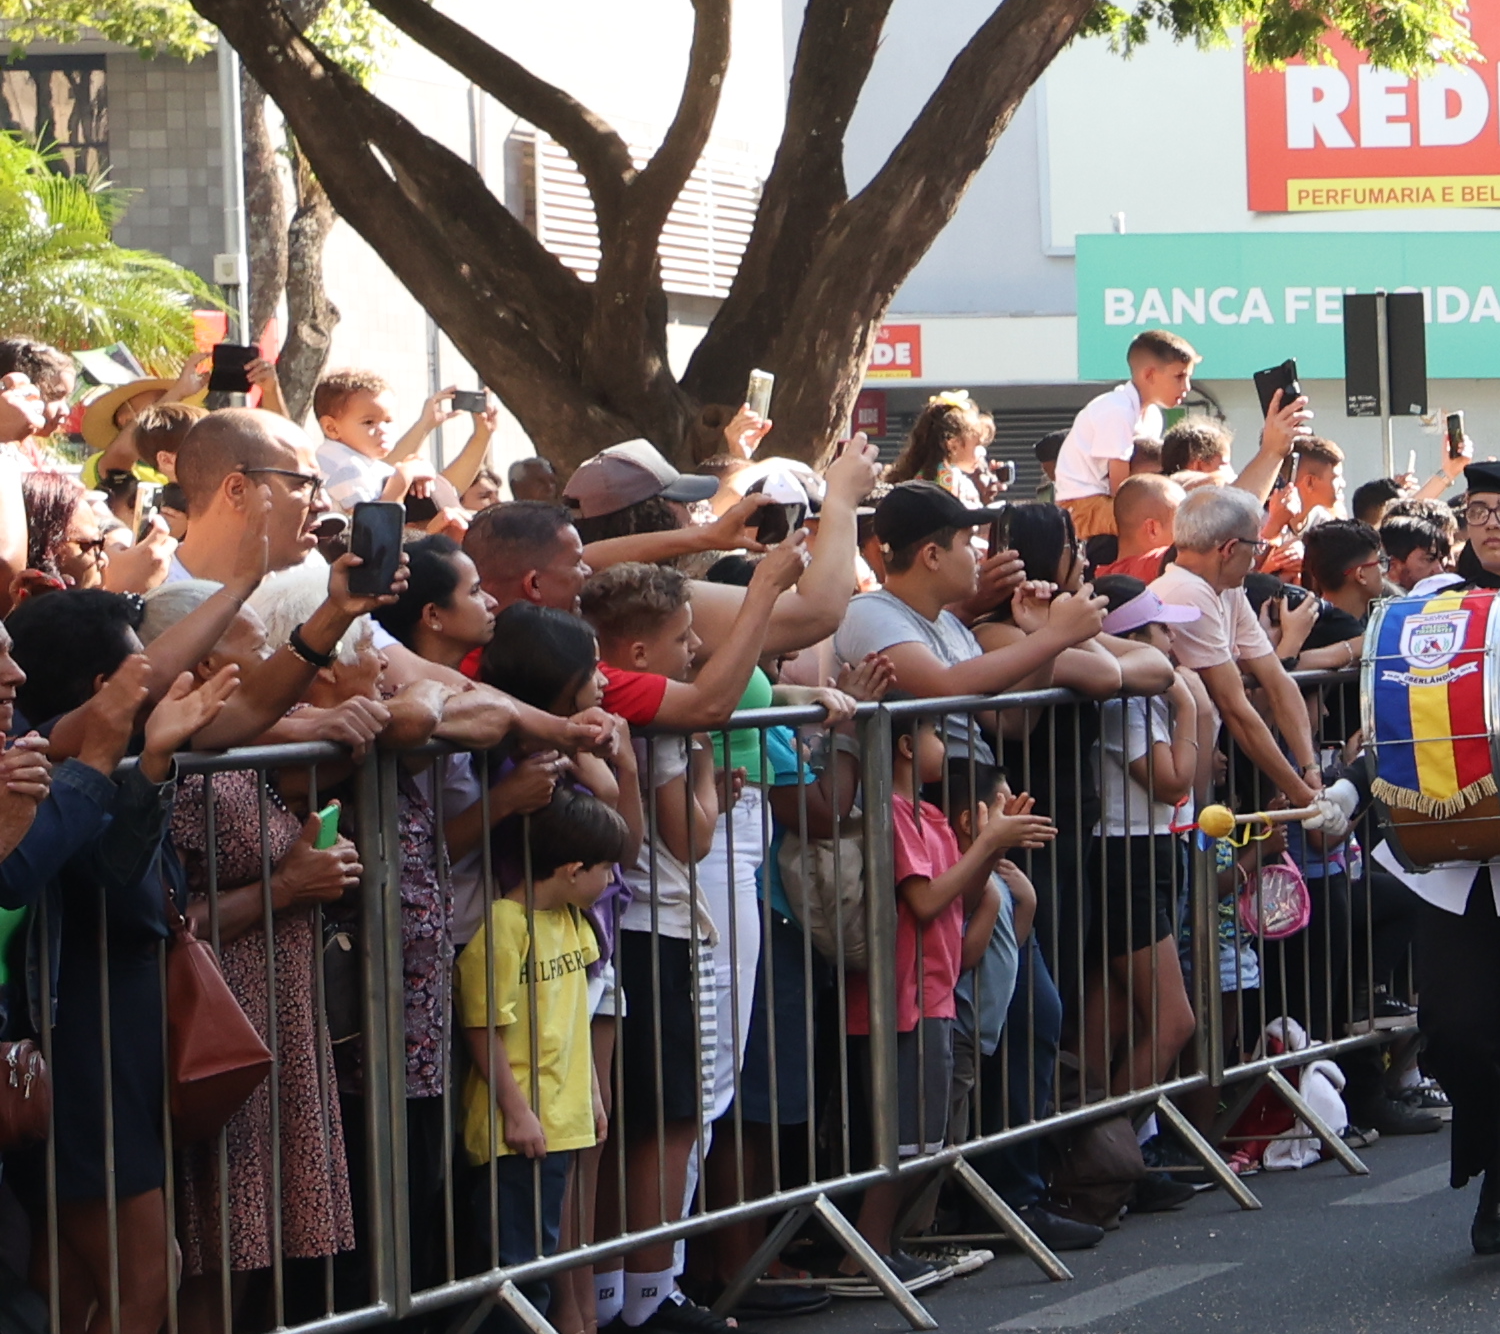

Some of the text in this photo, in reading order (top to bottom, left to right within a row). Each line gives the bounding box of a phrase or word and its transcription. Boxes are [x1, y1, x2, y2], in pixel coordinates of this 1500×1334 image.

[1297, 186, 1436, 206] PERFUMARIA
[1441, 186, 1454, 202] E
[1104, 287, 1275, 325] BANCA
[868, 342, 911, 365] DE
